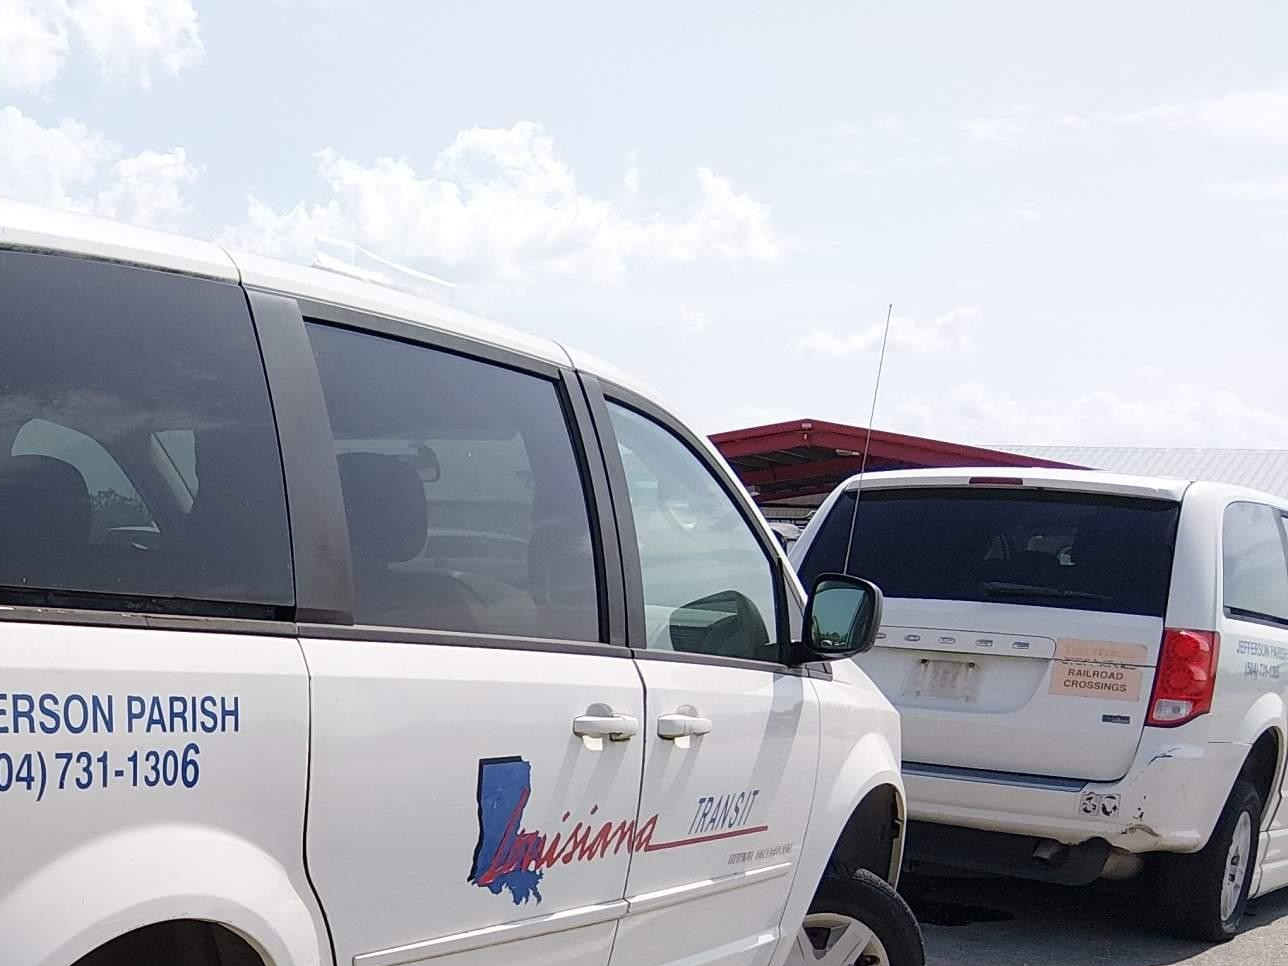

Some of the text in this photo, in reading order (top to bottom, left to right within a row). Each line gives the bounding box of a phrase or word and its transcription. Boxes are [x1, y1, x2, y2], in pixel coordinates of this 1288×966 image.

[1063, 679, 1127, 692] CROSSINGS
[1068, 668, 1123, 681] RAILROAD
[127, 695, 240, 733] PARISH
[55, 743, 200, 790] 731-1306
[476, 786, 760, 886] Louisiana TRANSIT
